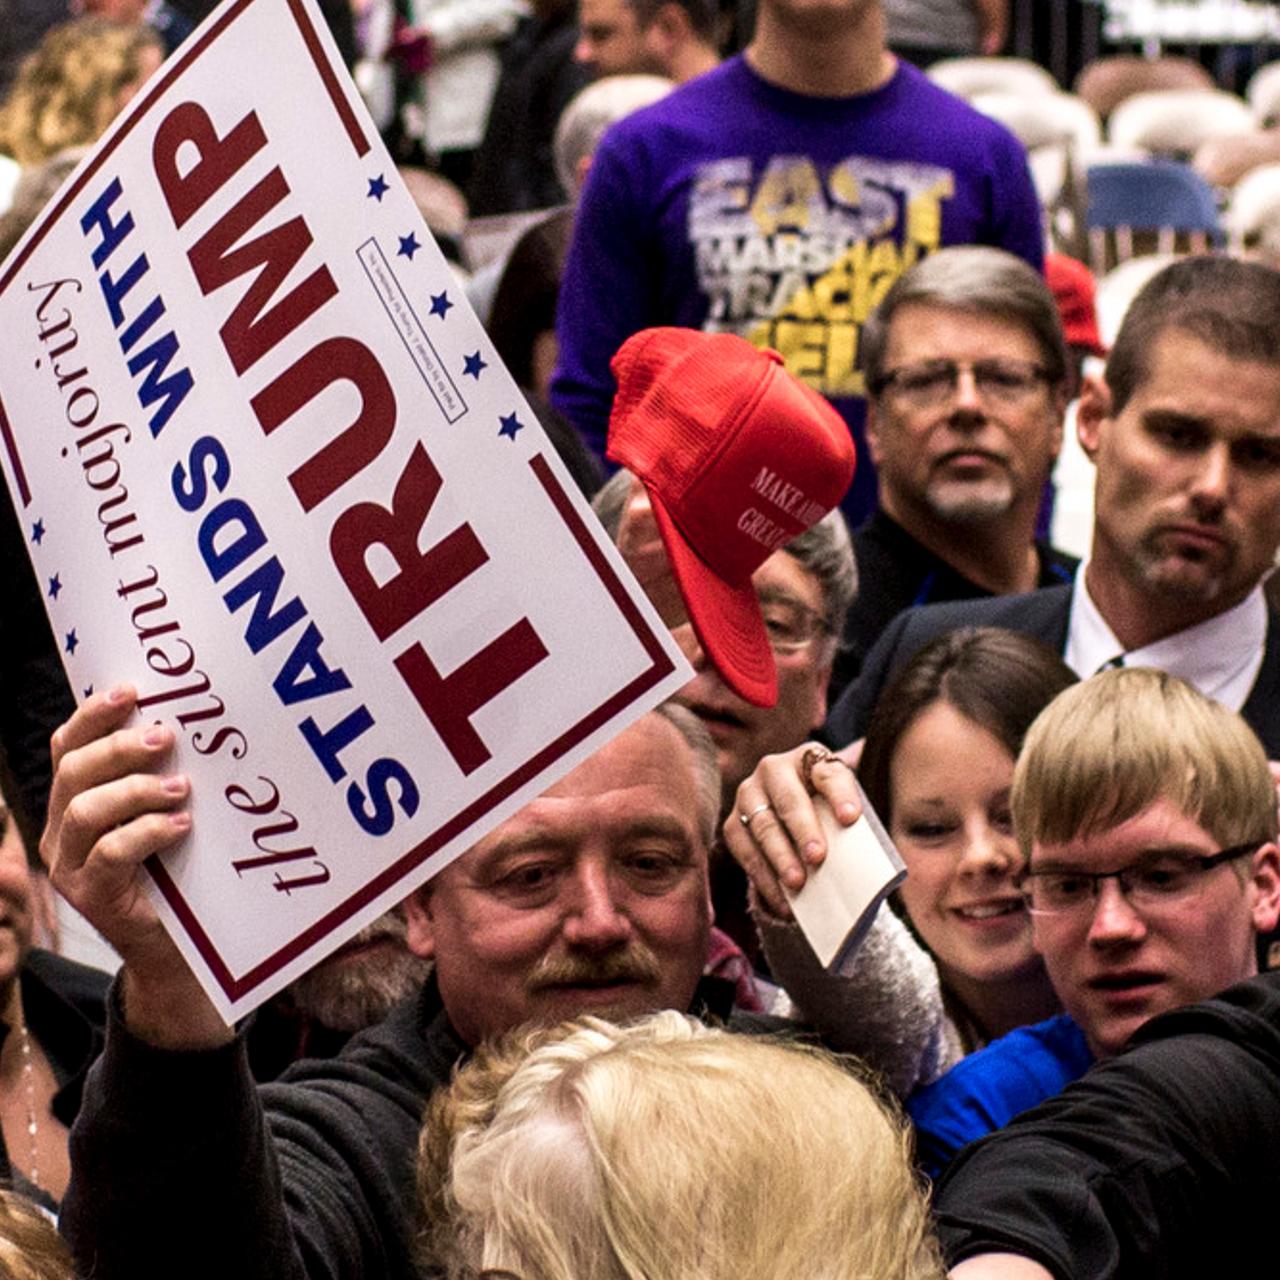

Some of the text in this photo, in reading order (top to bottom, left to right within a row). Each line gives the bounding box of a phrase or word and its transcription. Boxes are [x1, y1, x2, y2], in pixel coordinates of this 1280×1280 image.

[688, 156, 954, 242] EAST
[28, 277, 331, 897] the silent majority
[80, 175, 420, 837] STANDS WITH
[153, 99, 550, 778] TRUMP
[737, 507, 786, 551] GREA
[750, 466, 805, 514] MAKE
